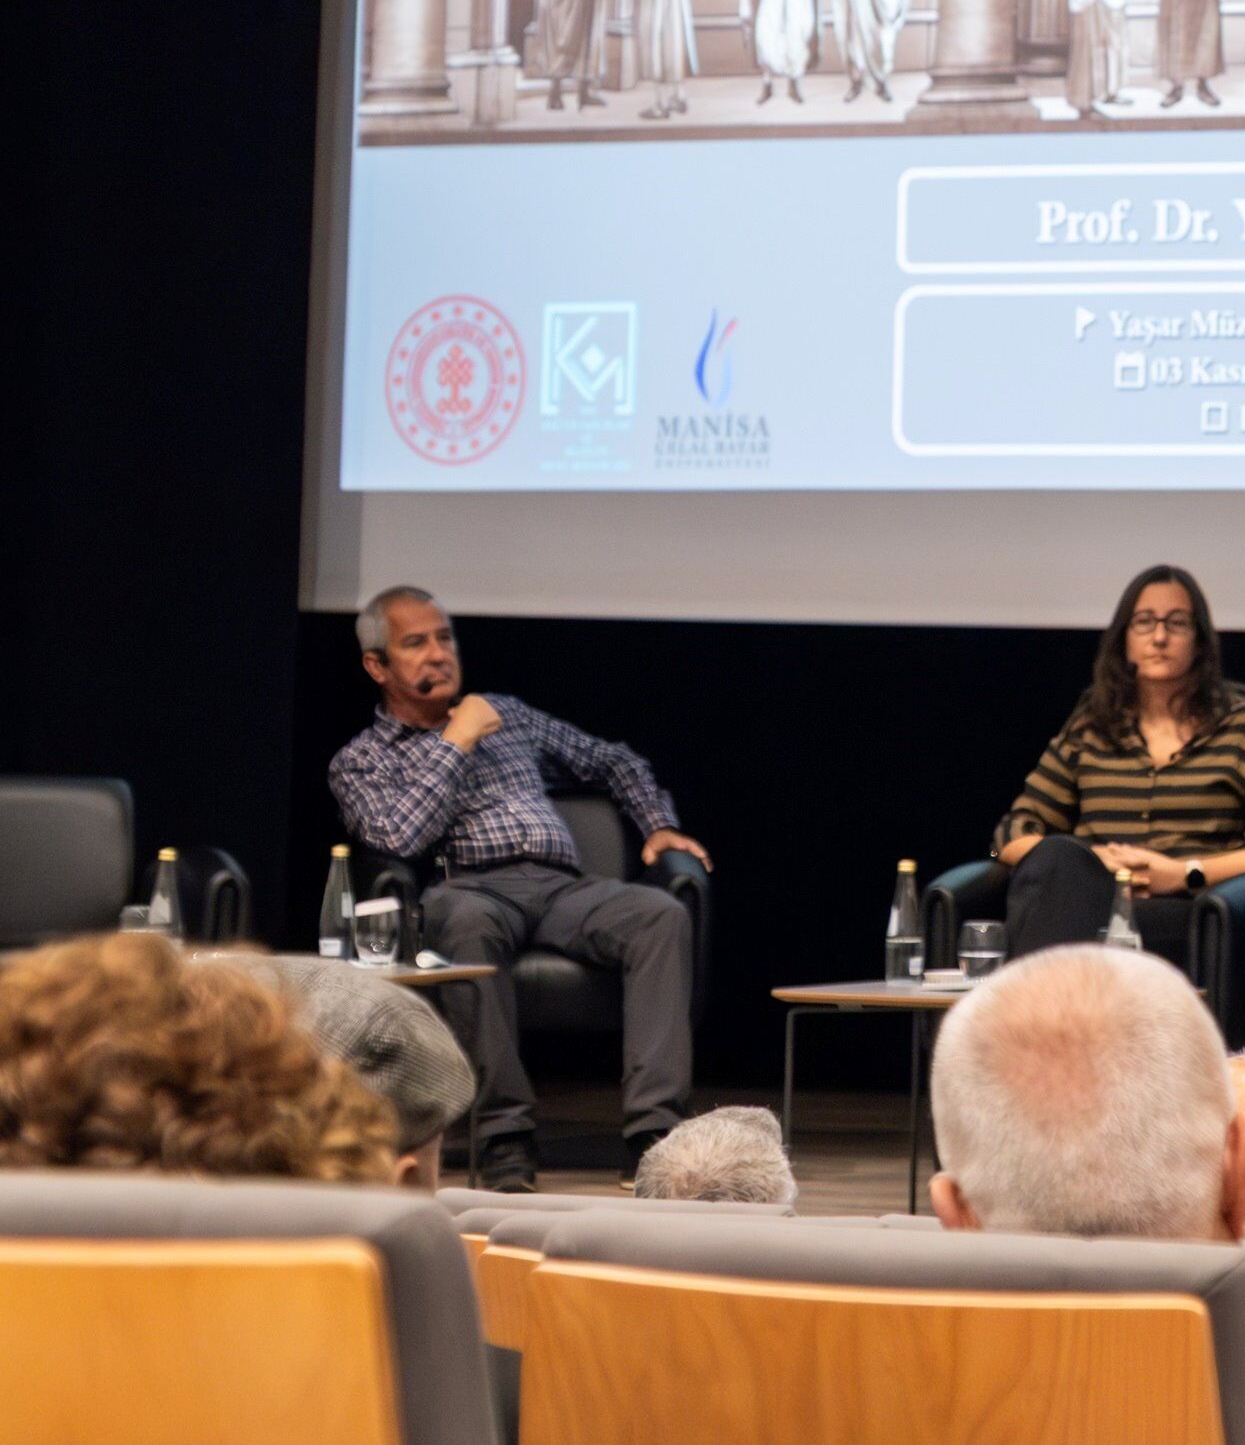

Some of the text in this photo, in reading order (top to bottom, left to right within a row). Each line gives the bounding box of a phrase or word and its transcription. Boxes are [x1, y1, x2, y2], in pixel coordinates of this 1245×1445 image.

[1036, 198, 1139, 244] Prof.
[1153, 198, 1219, 243] Dr.
[1109, 309, 1183, 344] Yaşar
[1150, 357, 1183, 384] 03
